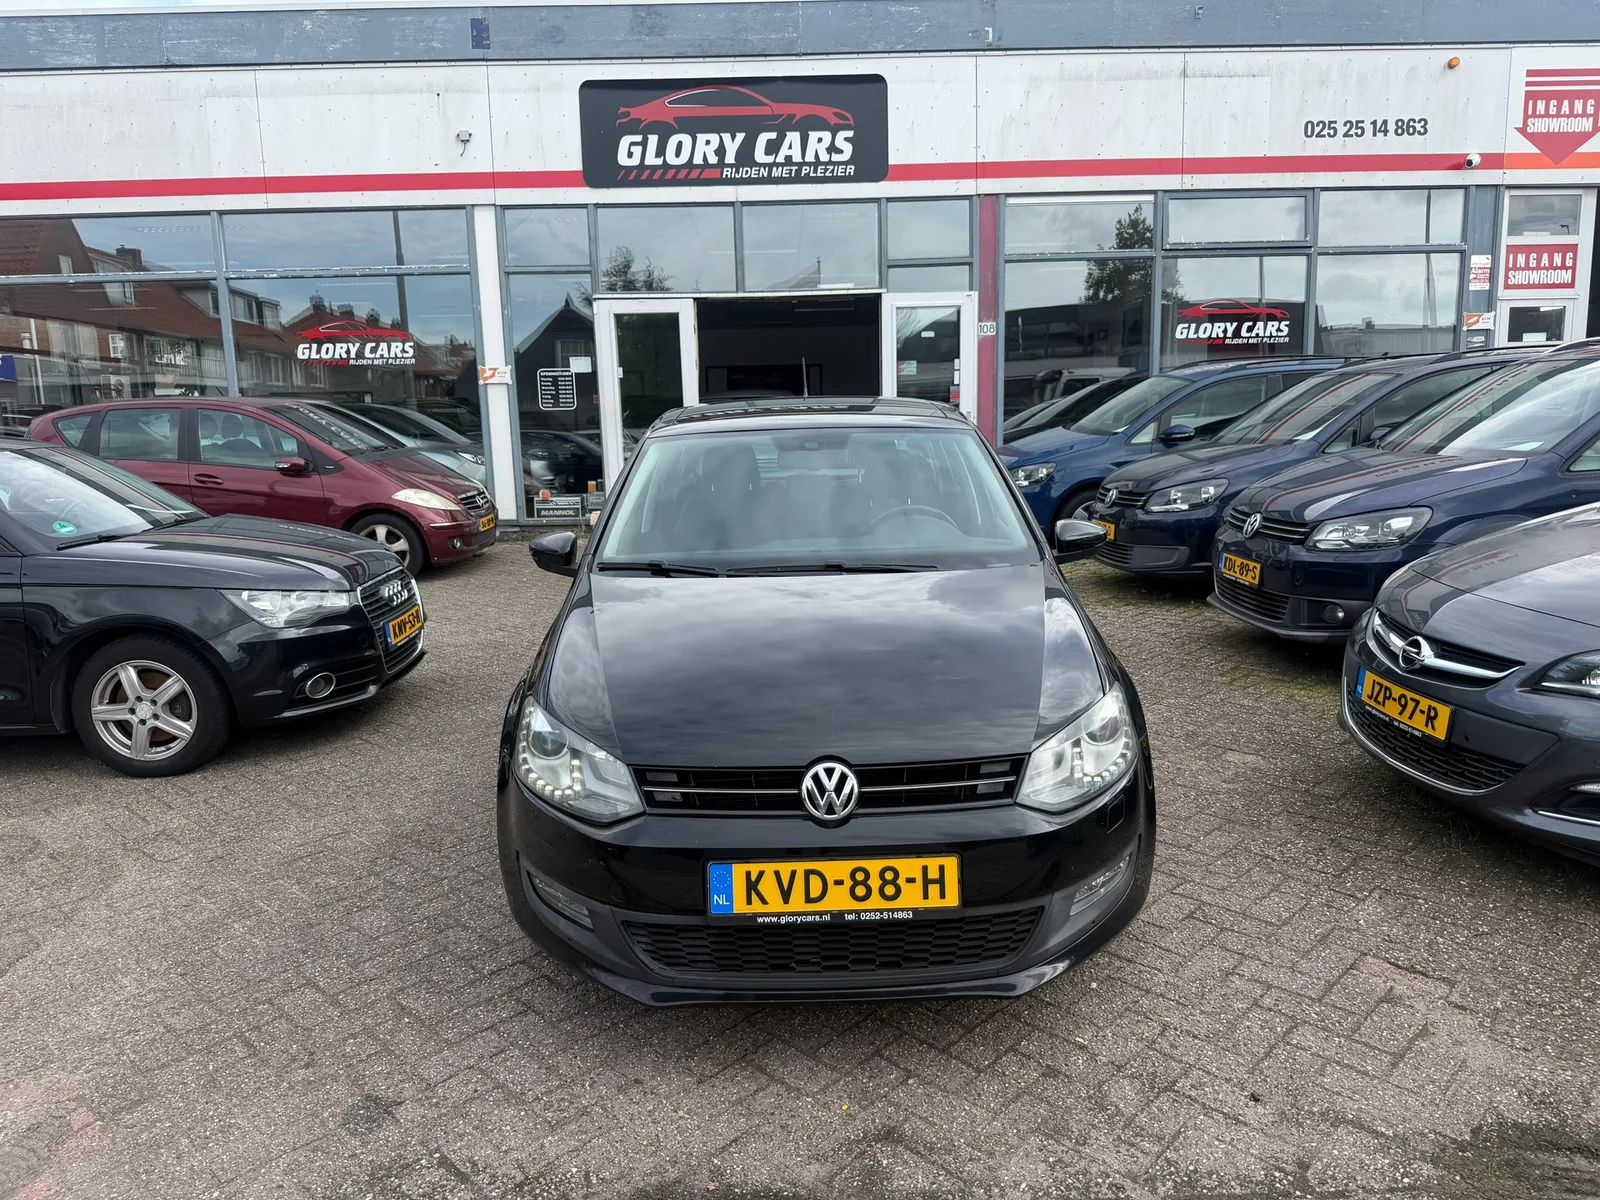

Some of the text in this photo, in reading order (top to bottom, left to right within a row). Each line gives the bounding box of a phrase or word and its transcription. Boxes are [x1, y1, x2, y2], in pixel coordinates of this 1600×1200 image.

[1527, 99, 1595, 115] INGANG
[1303, 118, 1428, 138] 025 25 14 863
[1526, 117, 1593, 133] SHOWROOM
[617, 130, 855, 166] GLORY CARS
[722, 165, 855, 179] RIJDEN MET PLEZIER
[1508, 252, 1574, 268] INGANG
[1507, 269, 1572, 285] SHOWROOM
[979, 323, 995, 334] 108
[1175, 320, 1290, 339] GLORY CARS
[297, 341, 415, 360] GLORY CARS
[1367, 679, 1439, 732] JZP-97-R
[745, 864, 946, 906] KVD-88-H
[713, 894, 730, 905] NL
[757, 911, 913, 924] www.glorycars.nl tel: 0252-514863
